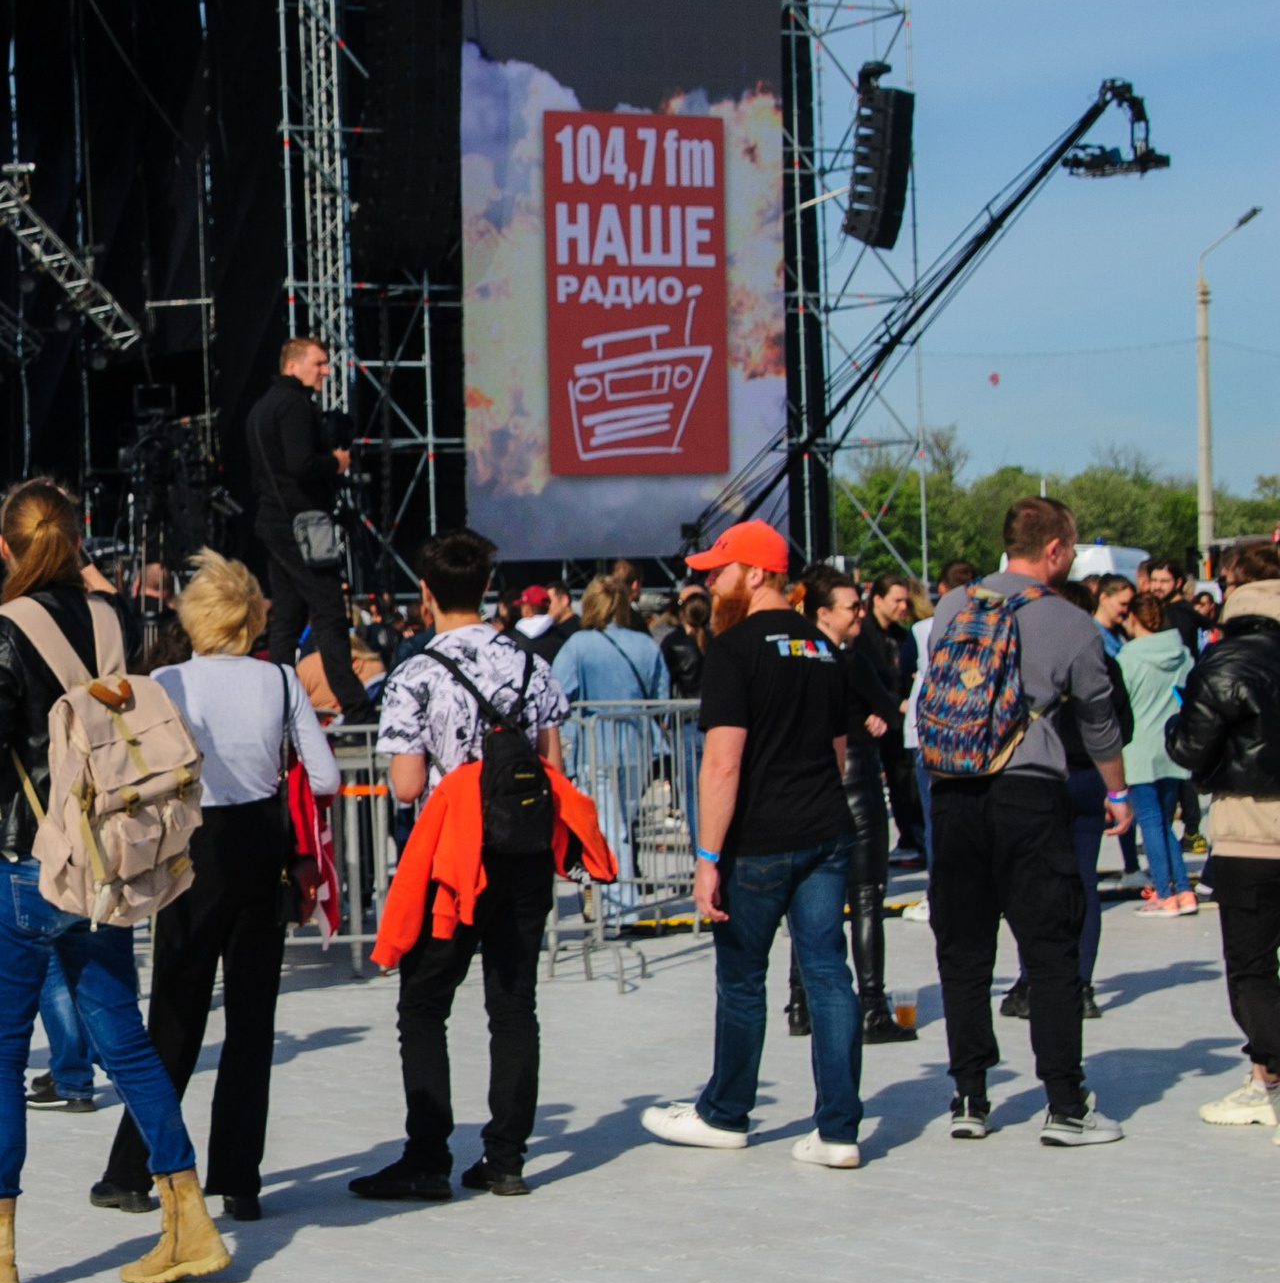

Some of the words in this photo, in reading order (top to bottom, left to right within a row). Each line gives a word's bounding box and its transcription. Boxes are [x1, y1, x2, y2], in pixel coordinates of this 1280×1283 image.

[554, 124, 658, 192] 104,7
[663, 128, 716, 188] fm
[554, 202, 717, 268] НАШЕ
[556, 274, 685, 310] РАДИО
